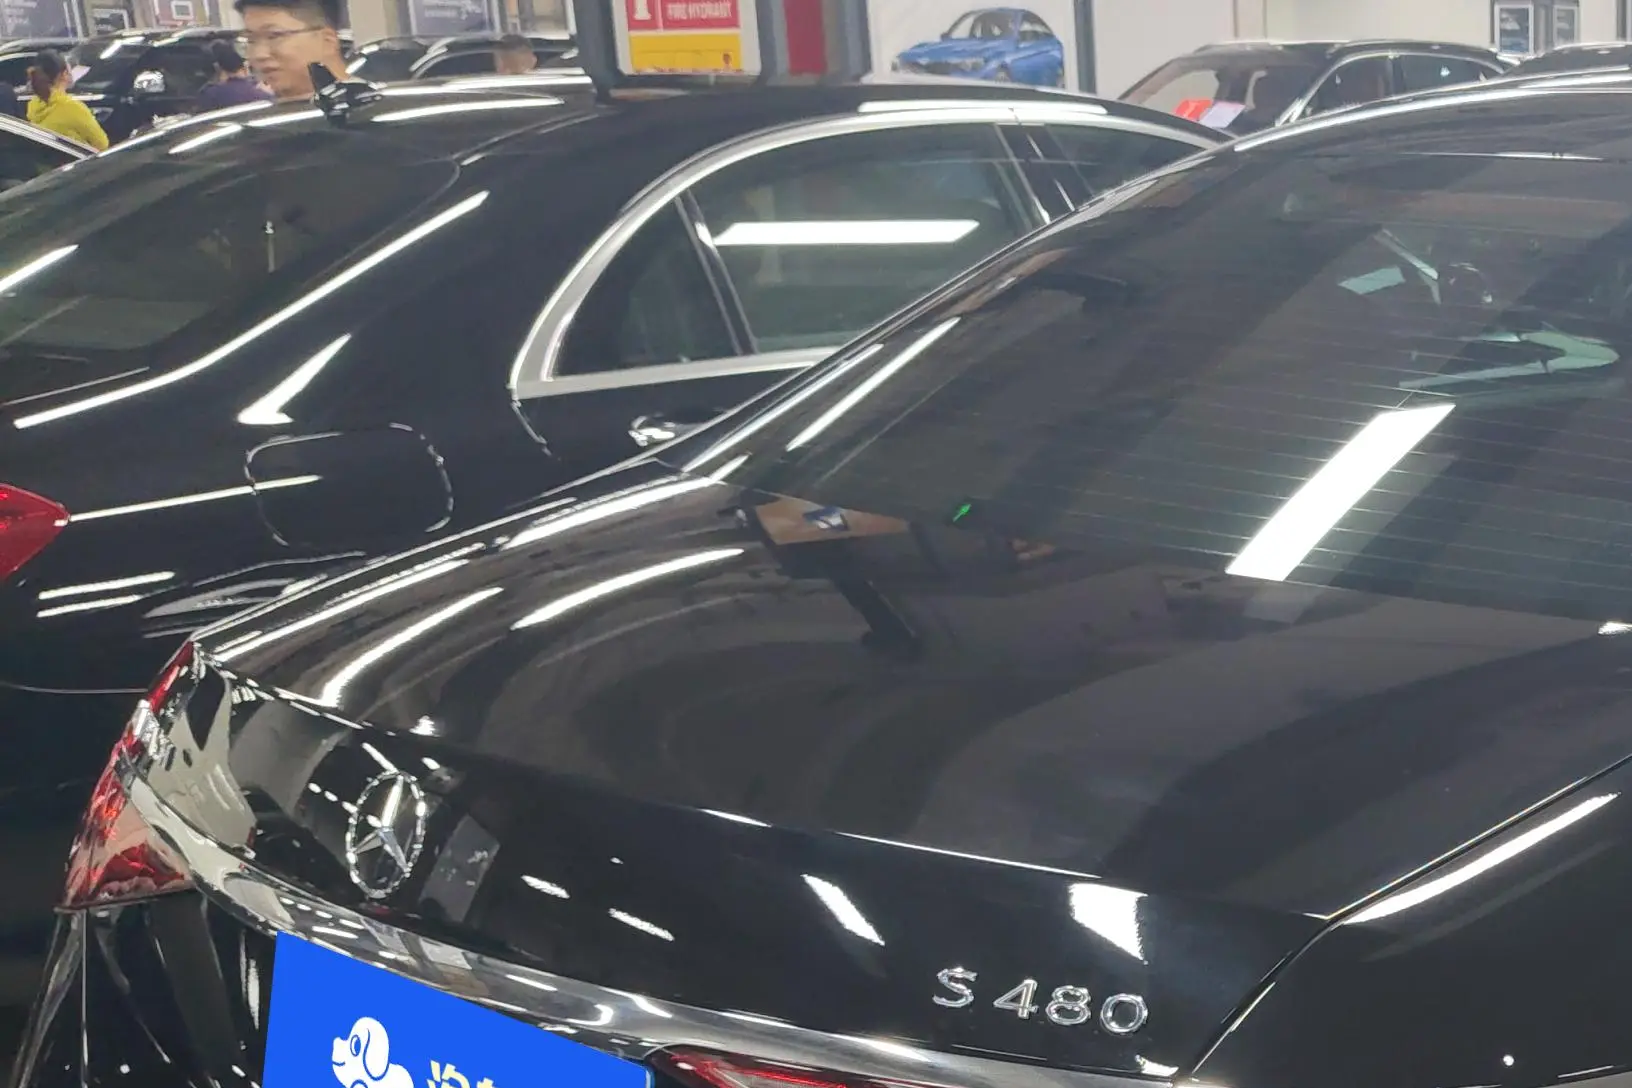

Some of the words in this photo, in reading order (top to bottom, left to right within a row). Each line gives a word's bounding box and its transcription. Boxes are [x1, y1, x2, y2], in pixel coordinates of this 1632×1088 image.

[666, 3, 687, 20] FIRE
[688, 1, 732, 19] HYDRANT
[932, 965, 979, 1009] S
[992, 977, 1149, 1034] 480
